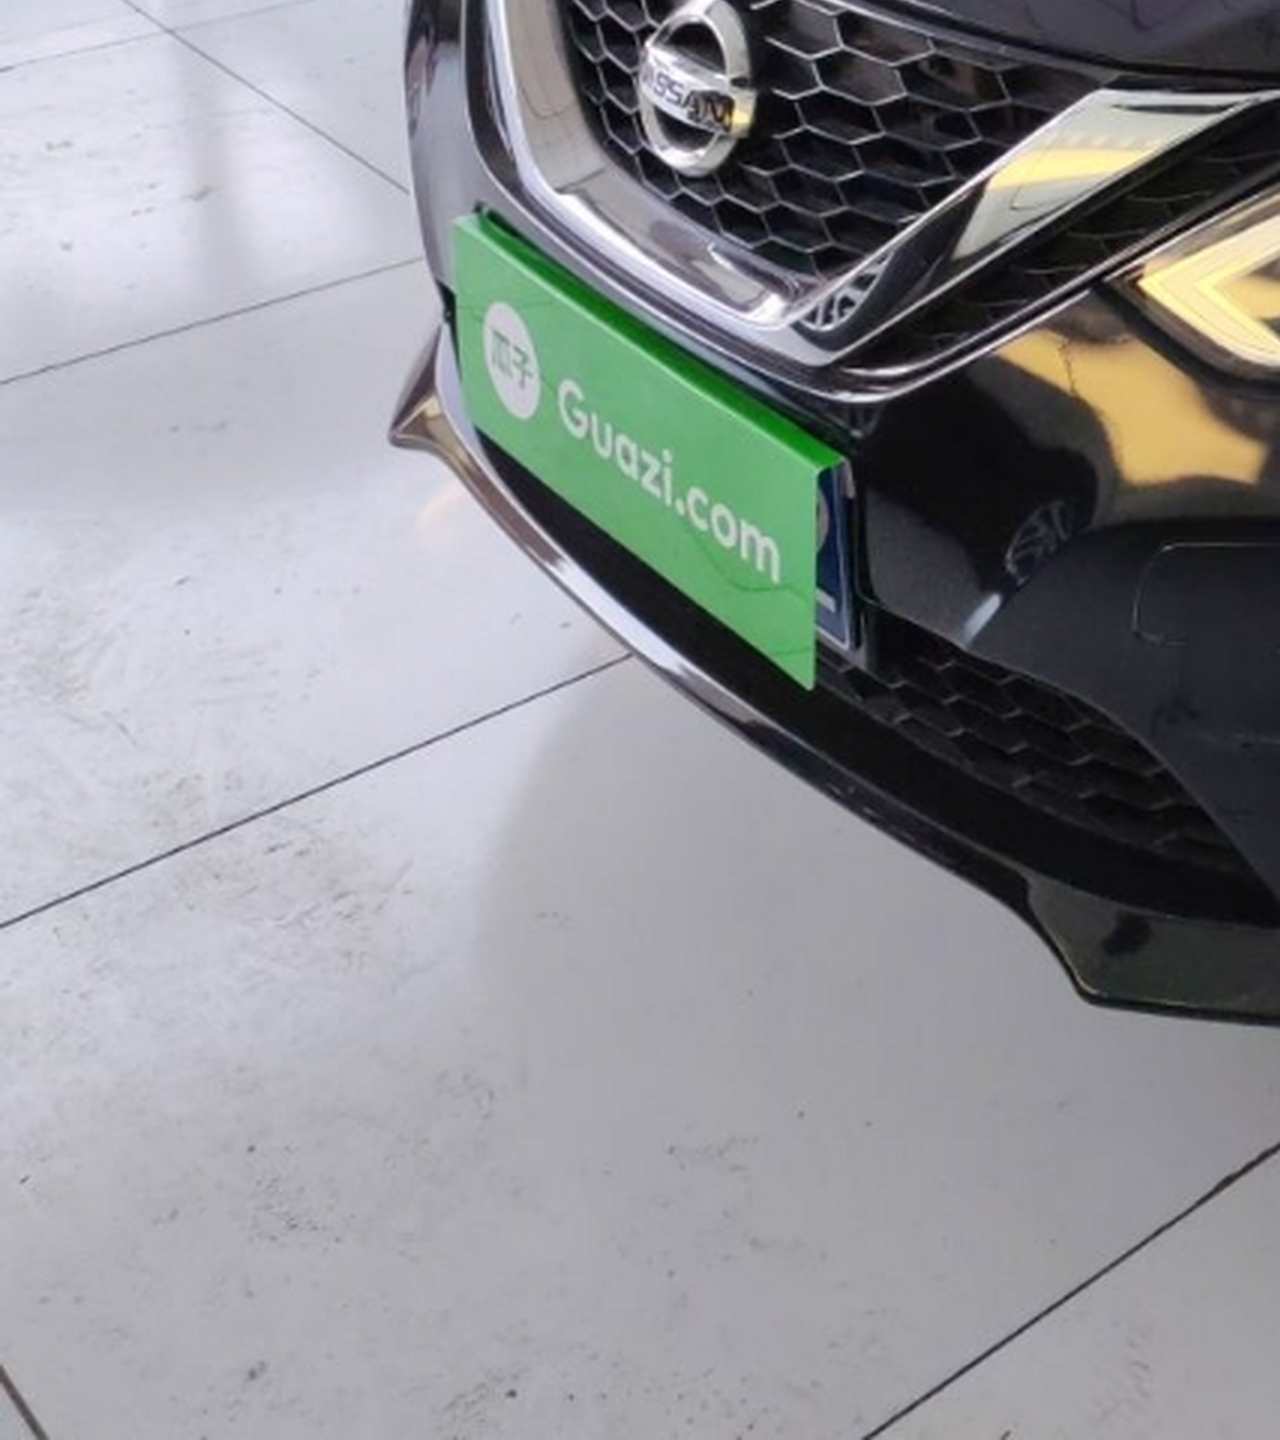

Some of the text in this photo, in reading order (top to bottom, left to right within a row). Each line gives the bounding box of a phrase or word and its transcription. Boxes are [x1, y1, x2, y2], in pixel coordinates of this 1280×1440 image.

[642, 64, 736, 133] NISSAN
[489, 327, 533, 391] 瓜子
[557, 378, 781, 585] Guazi.com
